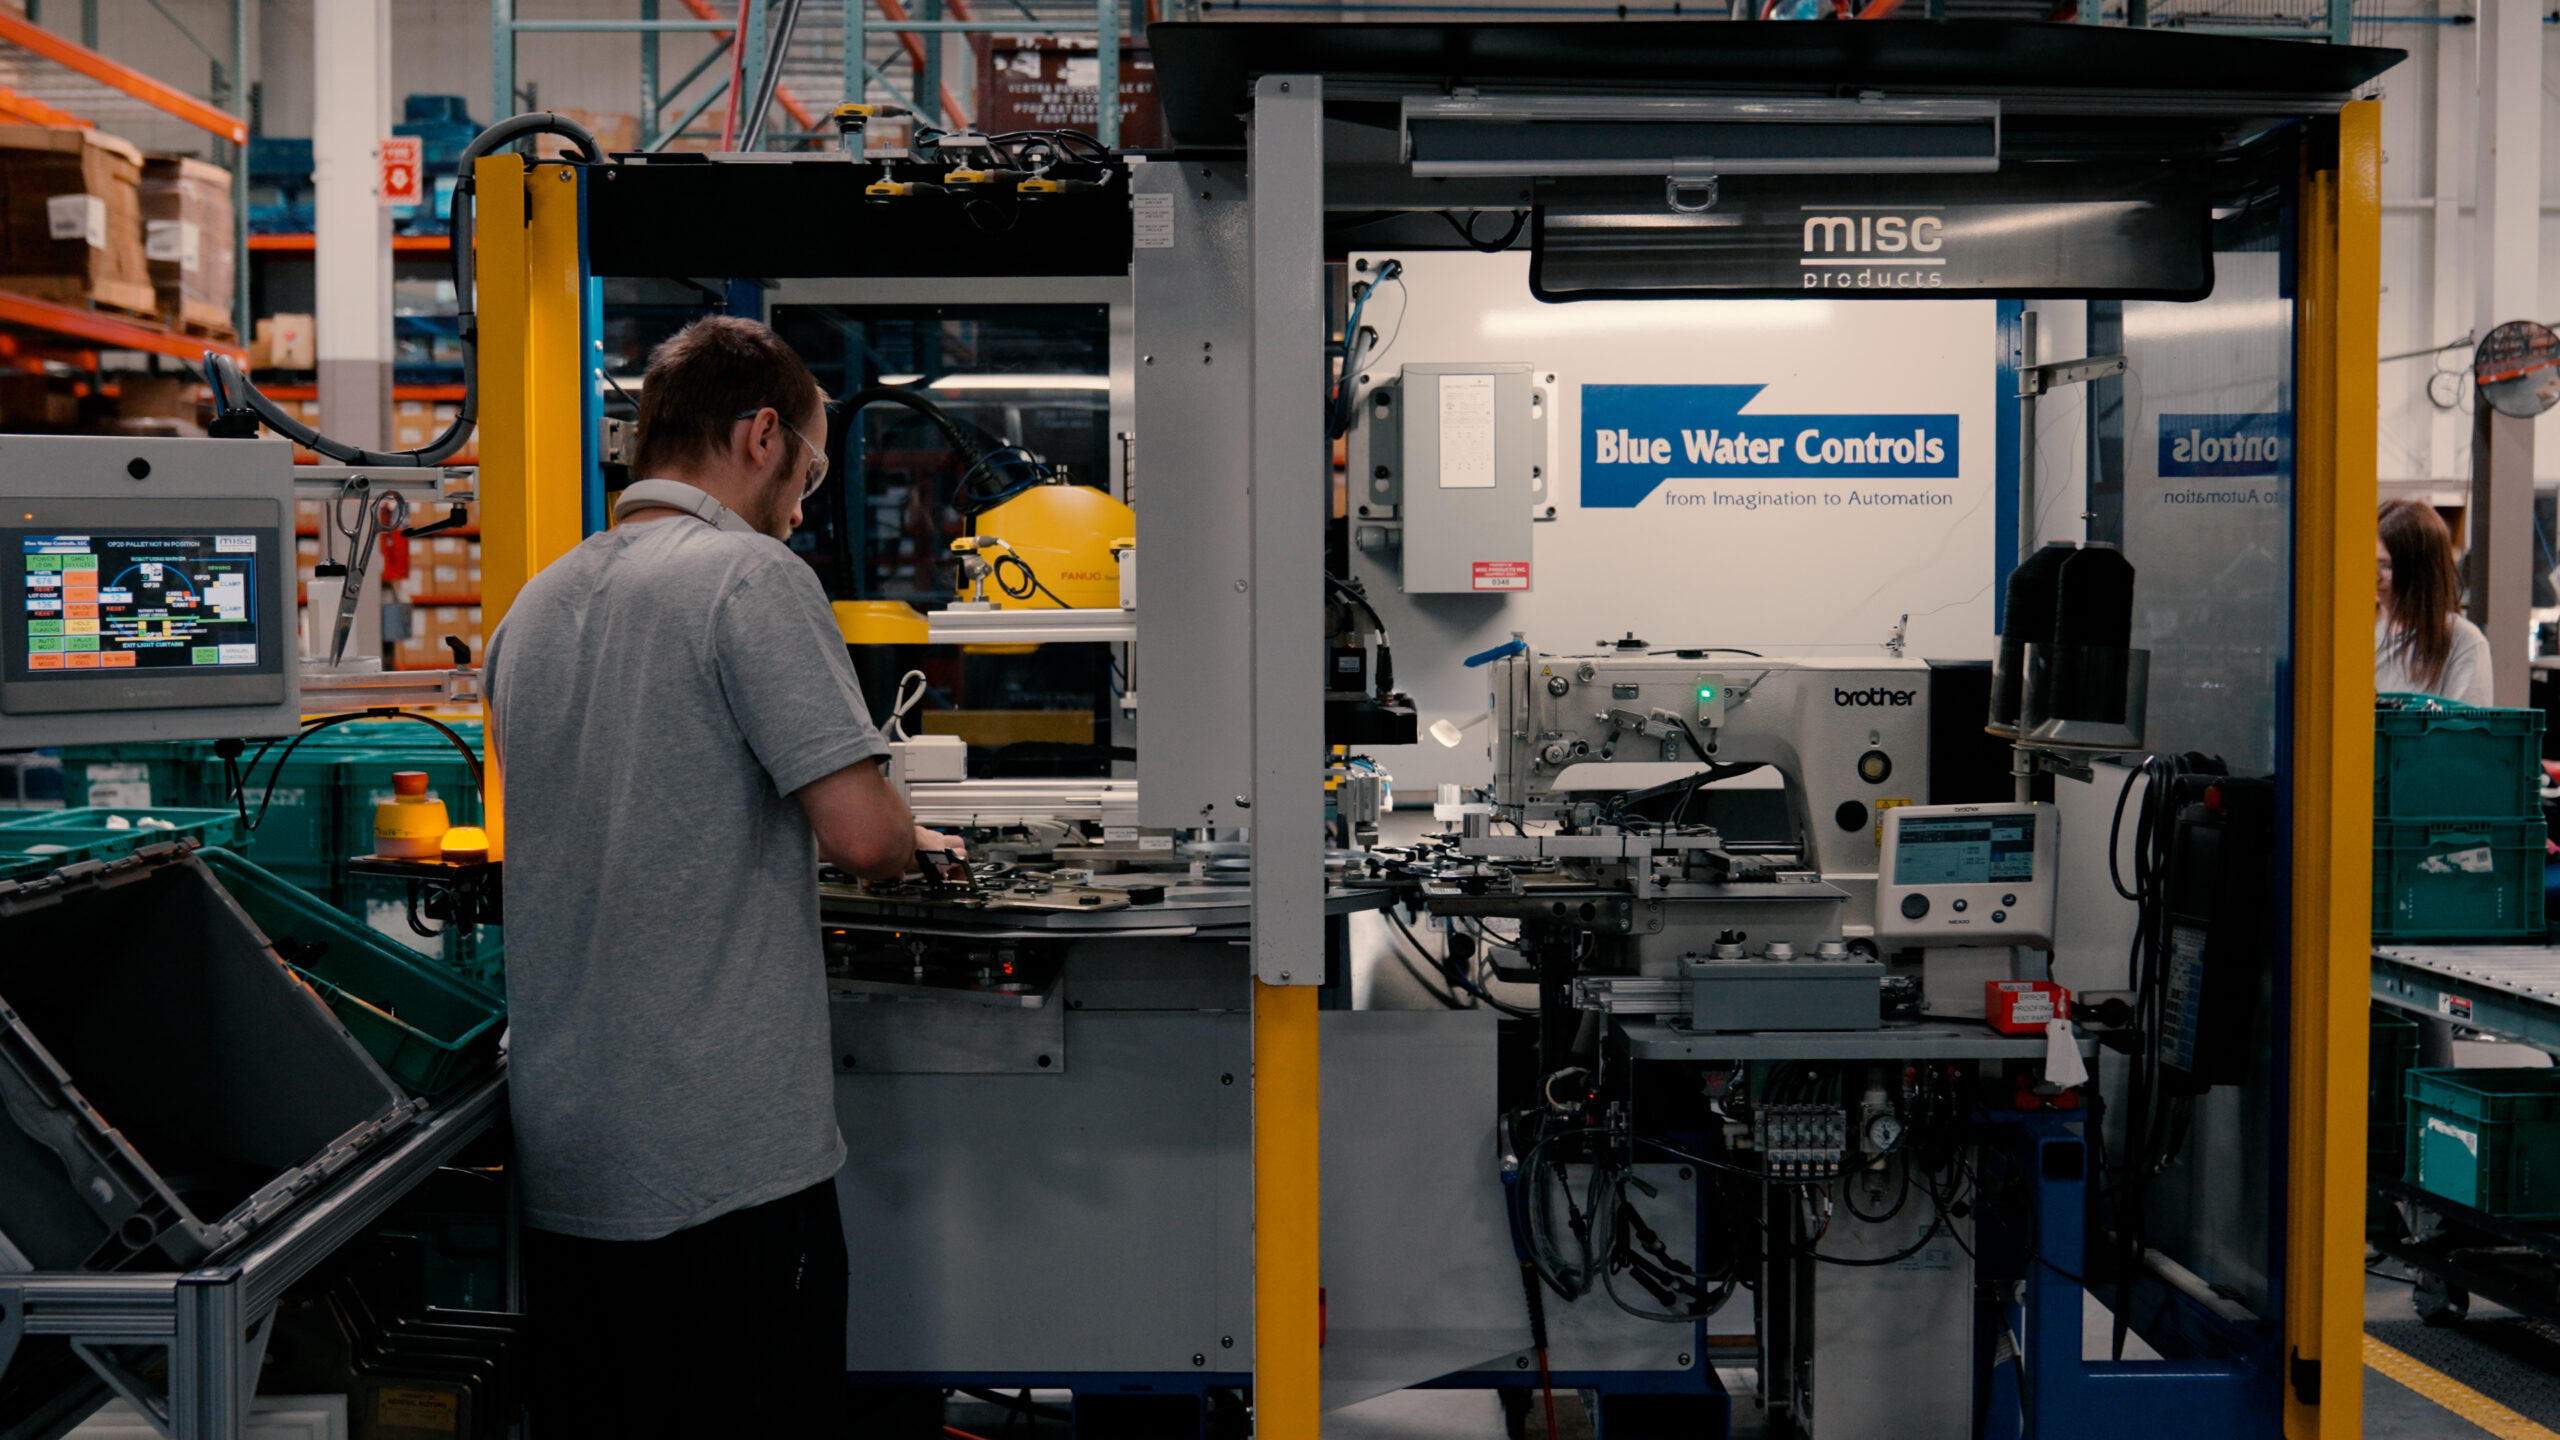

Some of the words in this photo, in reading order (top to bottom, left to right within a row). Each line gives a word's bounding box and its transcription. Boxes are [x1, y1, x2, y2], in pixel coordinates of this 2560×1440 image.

[1804, 269, 1942, 289] products
[1596, 429, 1672, 464] Blue
[1681, 429, 1785, 464] Water
[1795, 428, 1945, 464] Controls
[1665, 491, 1706, 505] from
[1713, 491, 1817, 510] Imagination
[1824, 493, 1841, 505] to
[1849, 491, 1954, 505] Automation
[1061, 572, 1102, 581] FANUC
[1834, 687, 1917, 707] brother
